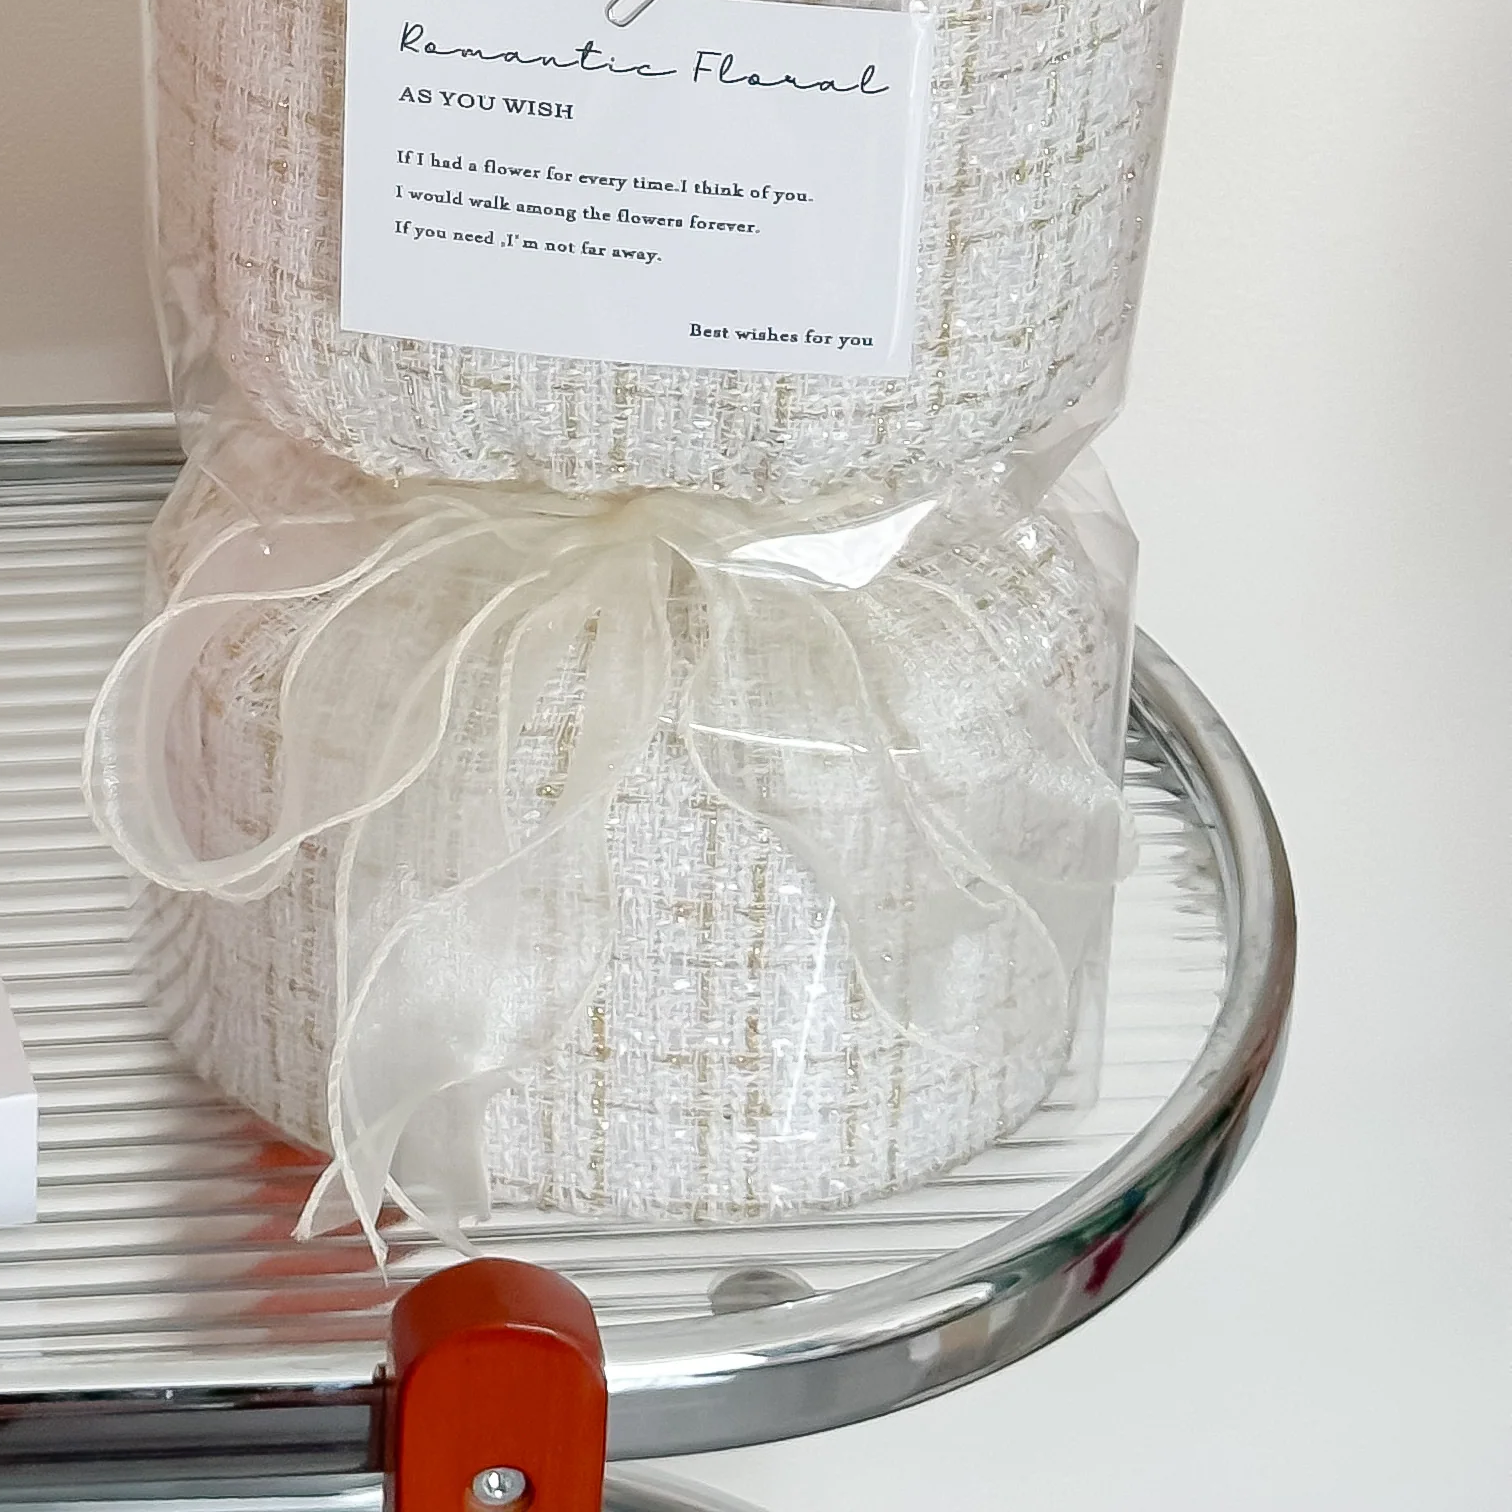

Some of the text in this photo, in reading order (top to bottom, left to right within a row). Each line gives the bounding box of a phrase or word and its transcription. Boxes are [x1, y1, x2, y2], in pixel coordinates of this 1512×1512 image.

[399, 22, 889, 95] Romantic Floral
[399, 86, 574, 119] AS YOU WISH
[397, 150, 413, 164] If
[417, 152, 424, 165] I
[431, 153, 462, 170] had
[469, 163, 478, 172] a
[484, 160, 541, 179] flower
[546, 166, 573, 182] for
[579, 173, 627, 191] every
[694, 179, 745, 198] think
[750, 185, 771, 199] of
[773, 189, 814, 204] you.
[396, 186, 761, 233] I would walk among the flowers forever.
[395, 220, 411, 234] If
[414, 225, 446, 240] you
[453, 231, 494, 245] need
[544, 240, 575, 254] not
[582, 241, 606, 256] far
[612, 247, 662, 264] away.
[690, 323, 874, 349] Best wishes for you
